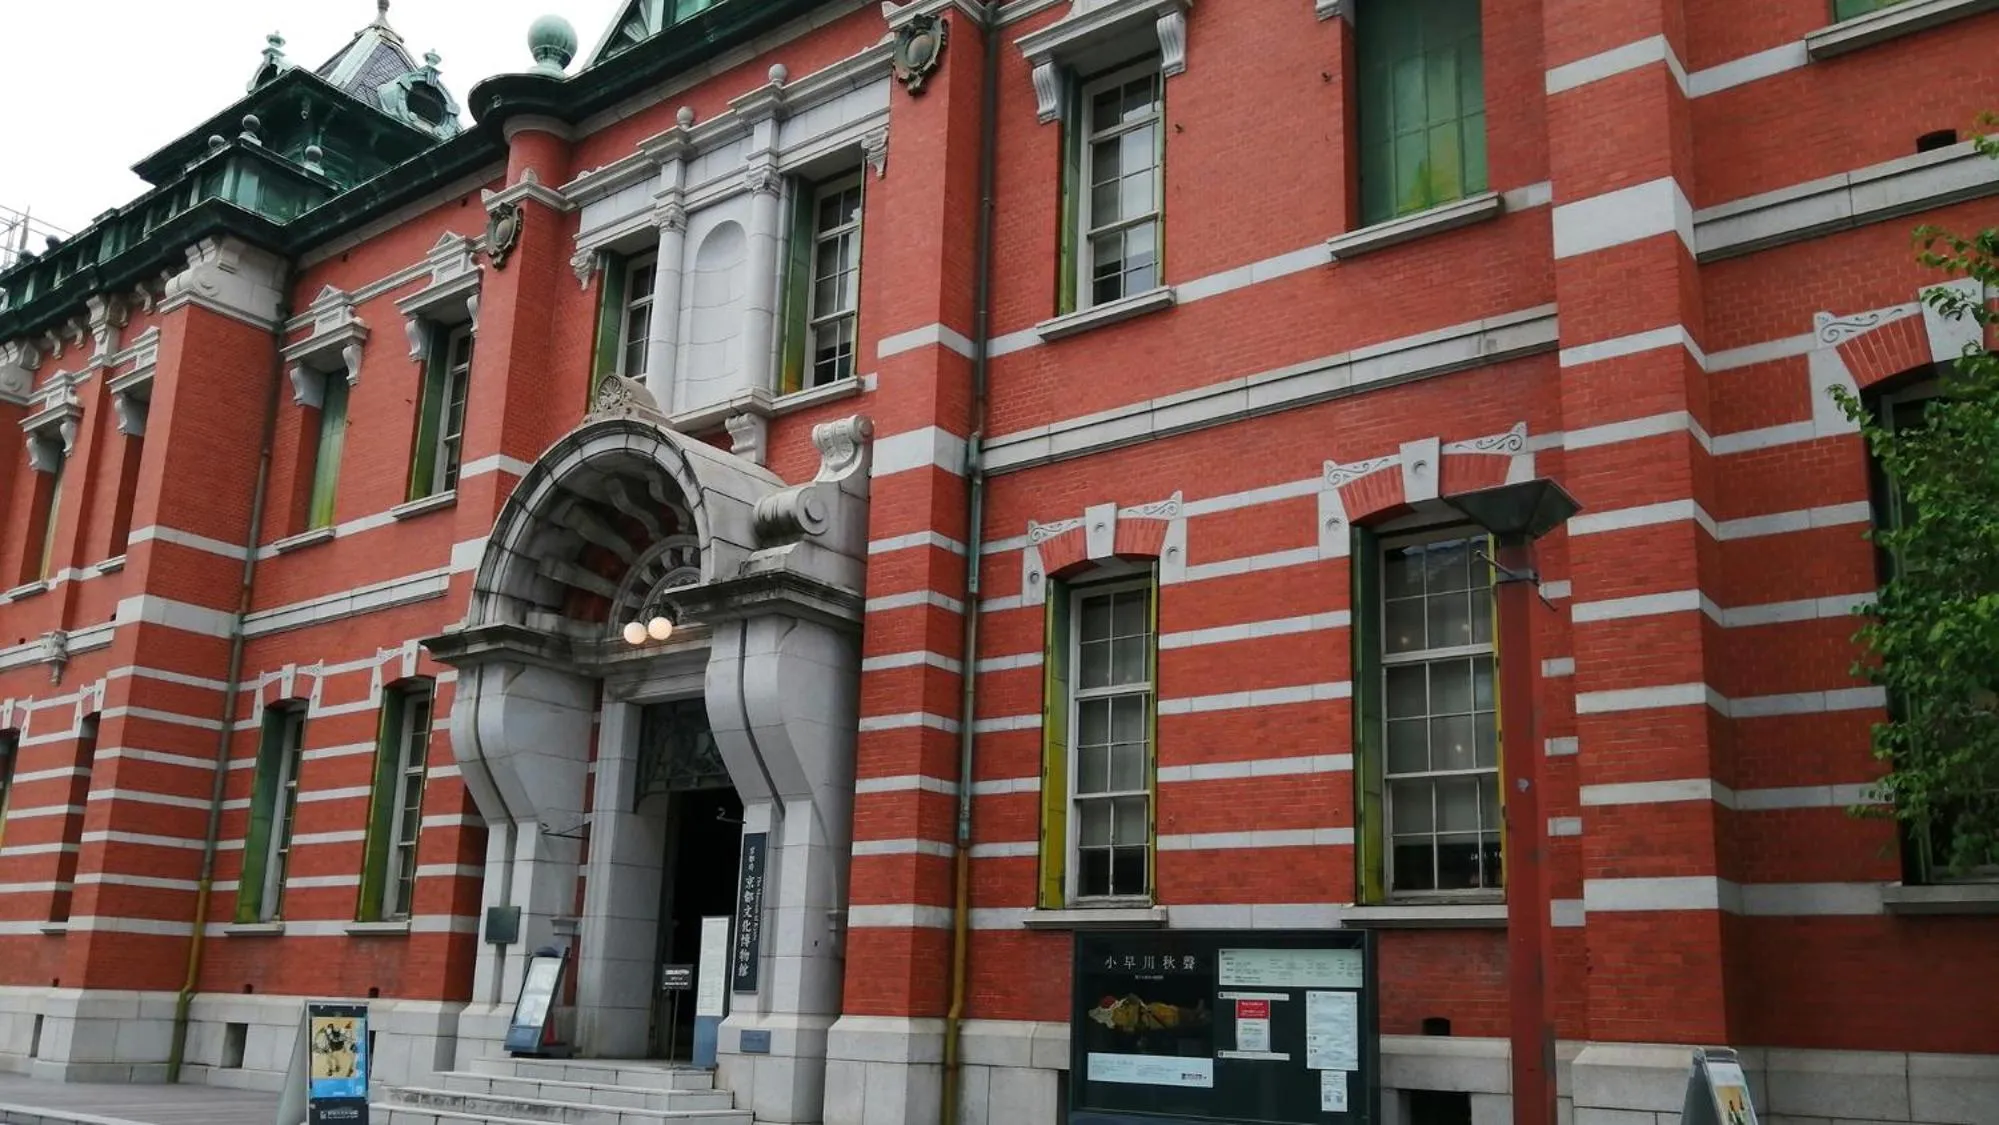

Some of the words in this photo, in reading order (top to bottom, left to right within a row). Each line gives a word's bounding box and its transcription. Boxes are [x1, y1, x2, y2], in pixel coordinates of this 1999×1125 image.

[738, 875, 755, 977] 京都文化博物館
